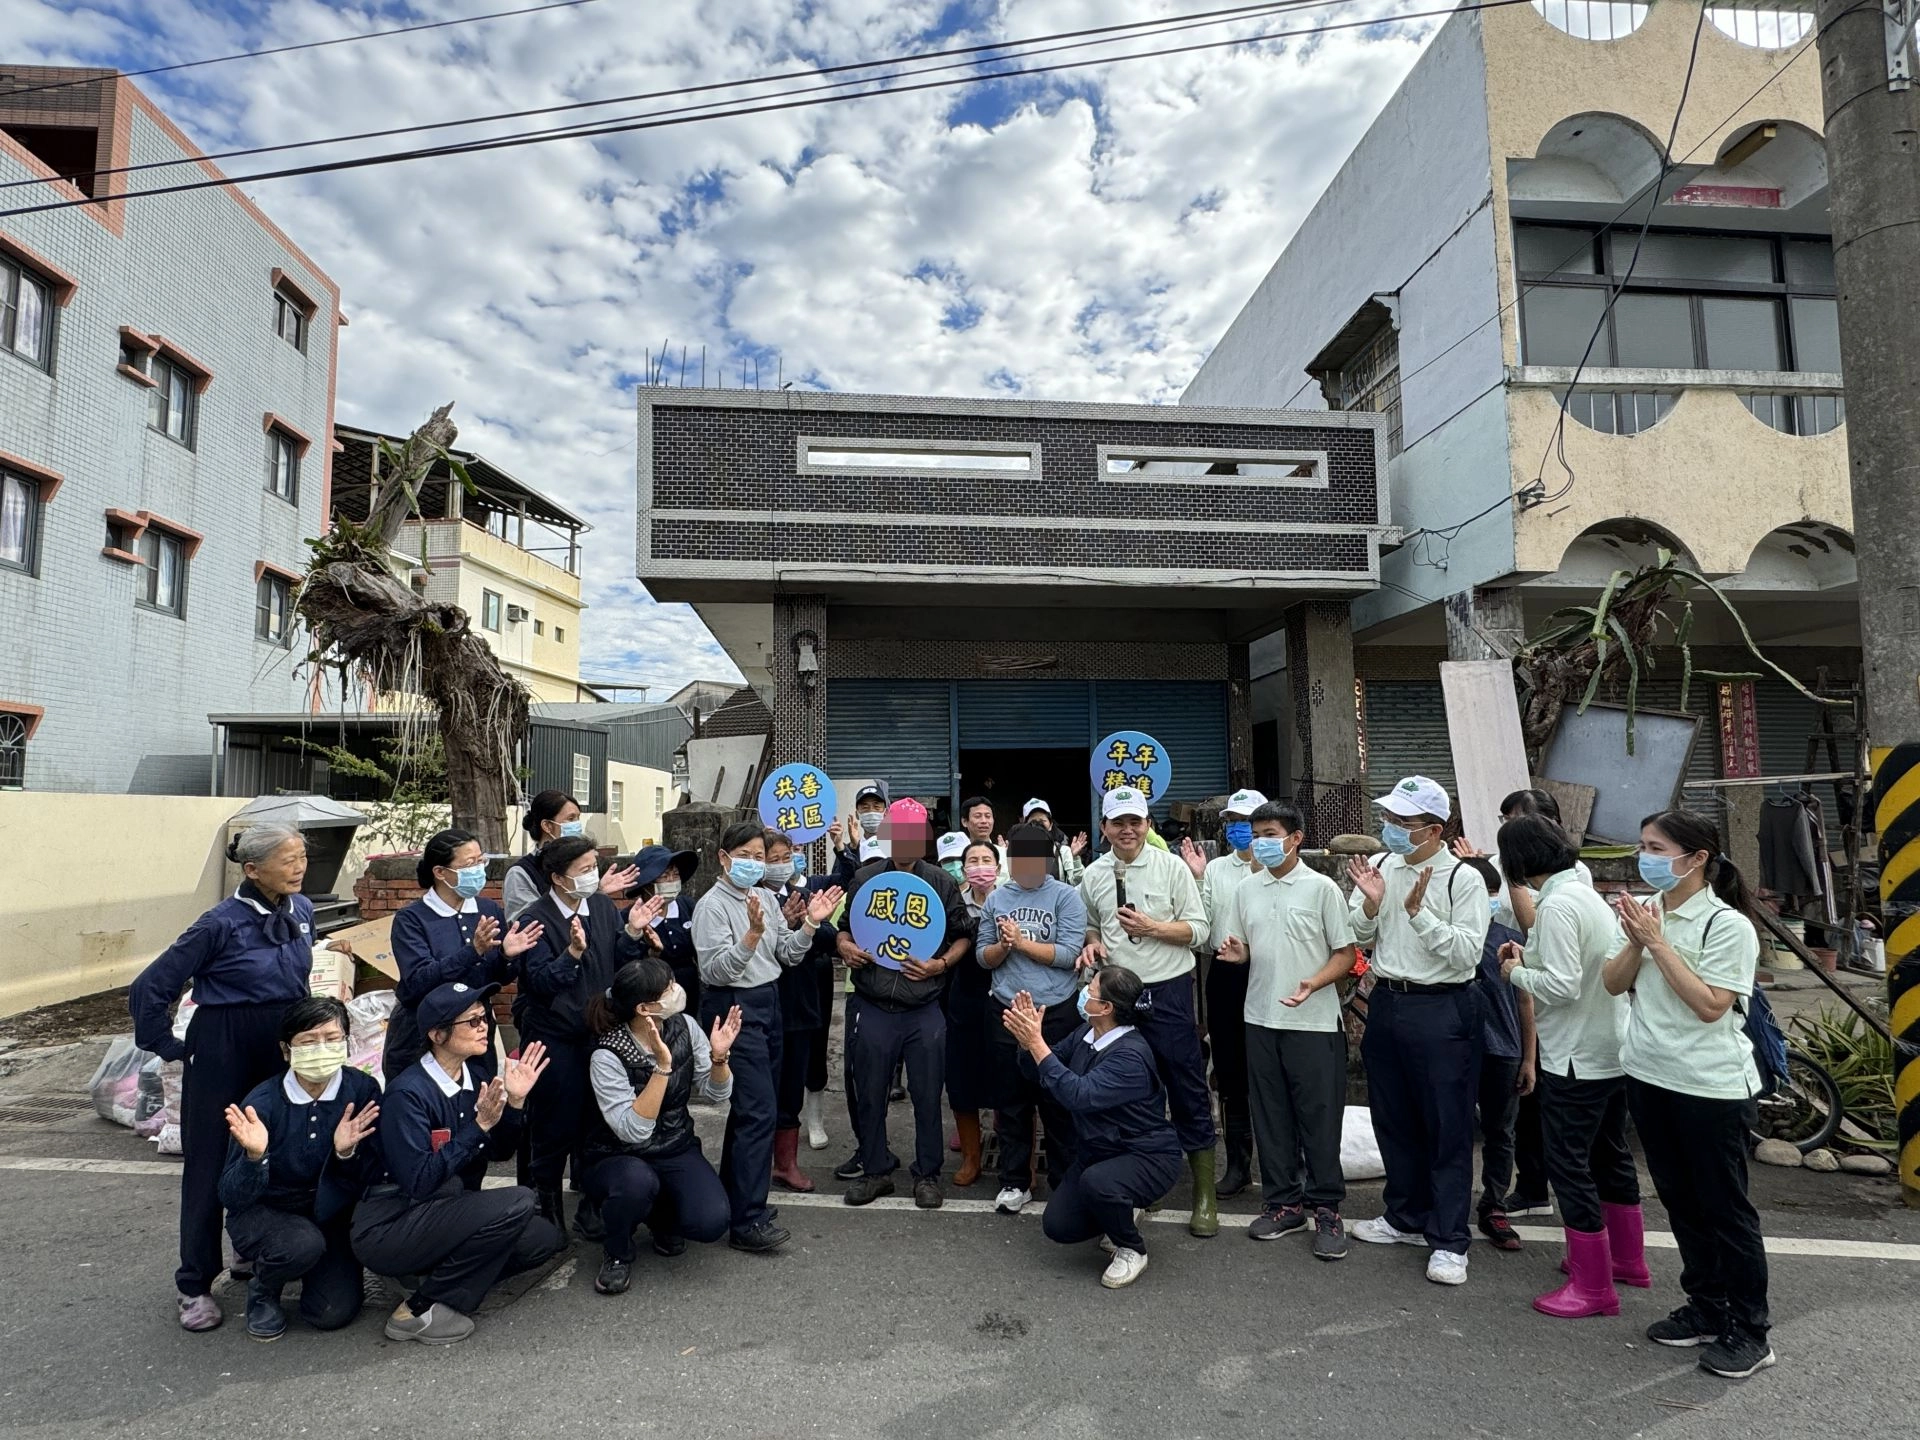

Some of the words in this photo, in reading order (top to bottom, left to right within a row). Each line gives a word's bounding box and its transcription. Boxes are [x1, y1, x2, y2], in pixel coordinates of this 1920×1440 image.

[1106, 740, 1158, 771] 年年
[773, 772, 823, 801] 共善
[777, 802, 826, 833] 社區
[865, 887, 931, 929] 感恩
[877, 934, 912, 962] 心
